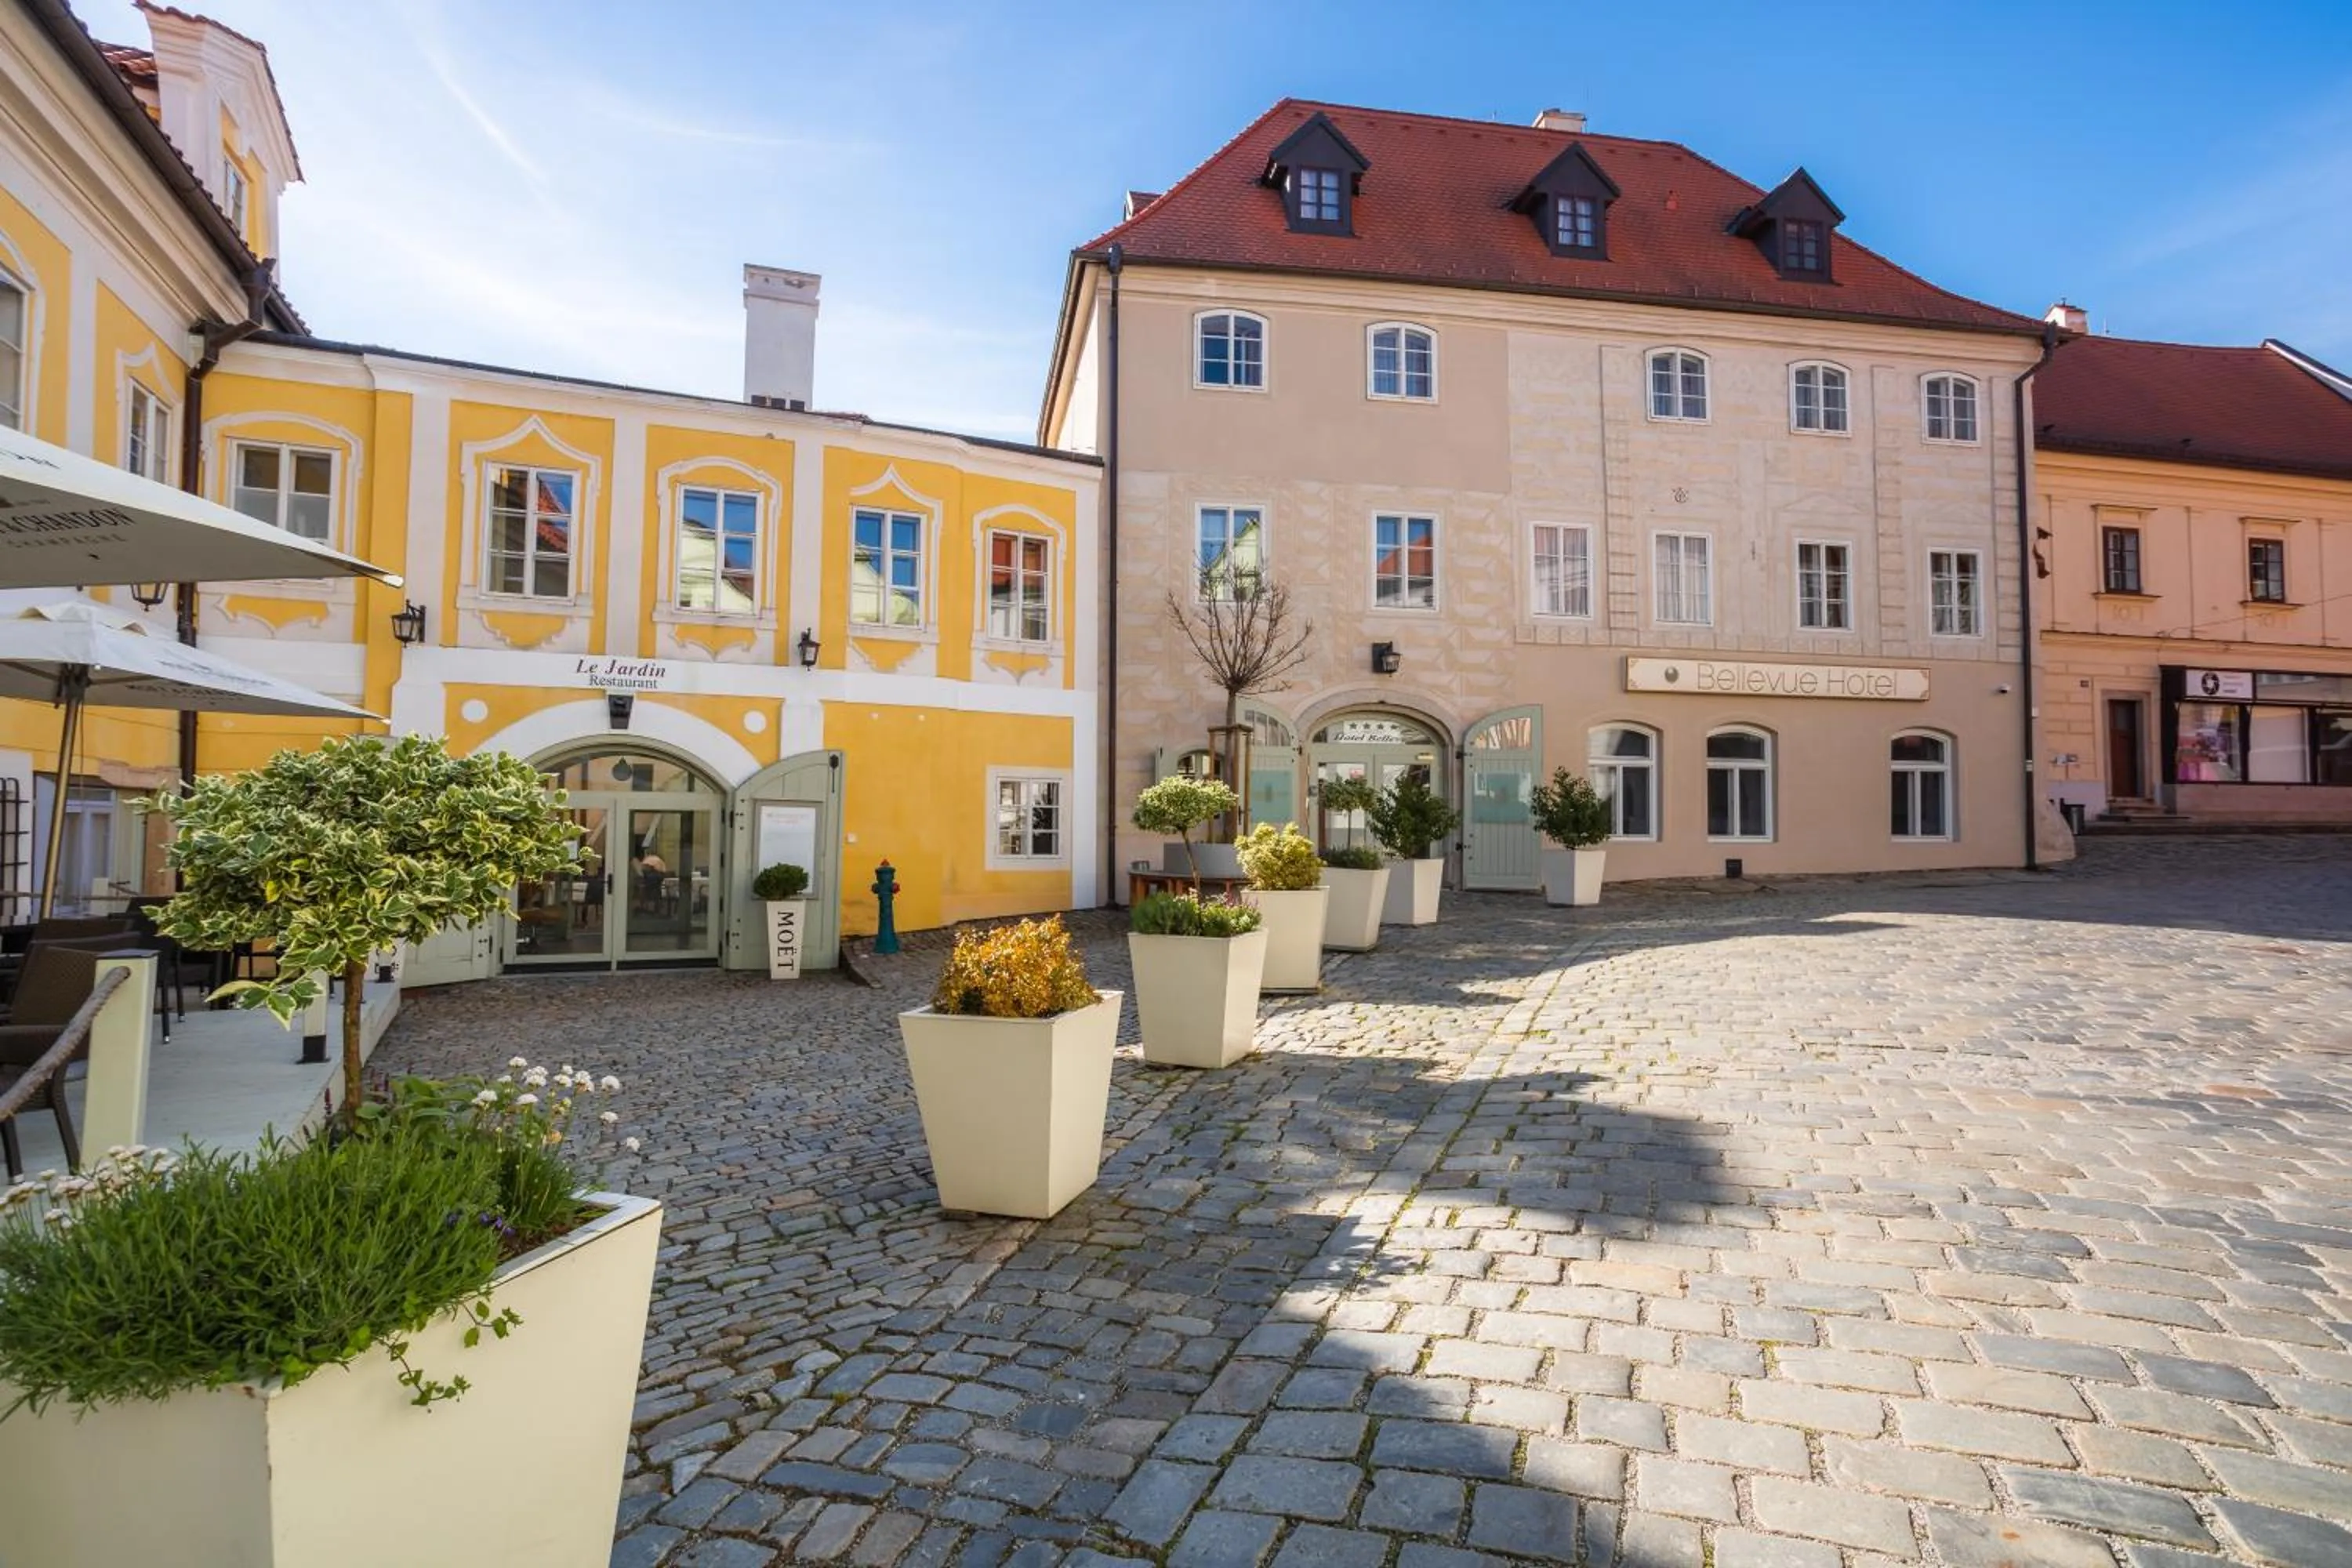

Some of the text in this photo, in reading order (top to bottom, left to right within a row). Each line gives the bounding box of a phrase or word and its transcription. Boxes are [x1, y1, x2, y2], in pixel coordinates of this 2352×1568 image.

[576, 659, 666, 678] Le Jardin
[589, 674, 659, 689] Restaurant
[1696, 662, 1898, 697] Bellevue Hotel
[777, 911, 798, 971] MOËT
